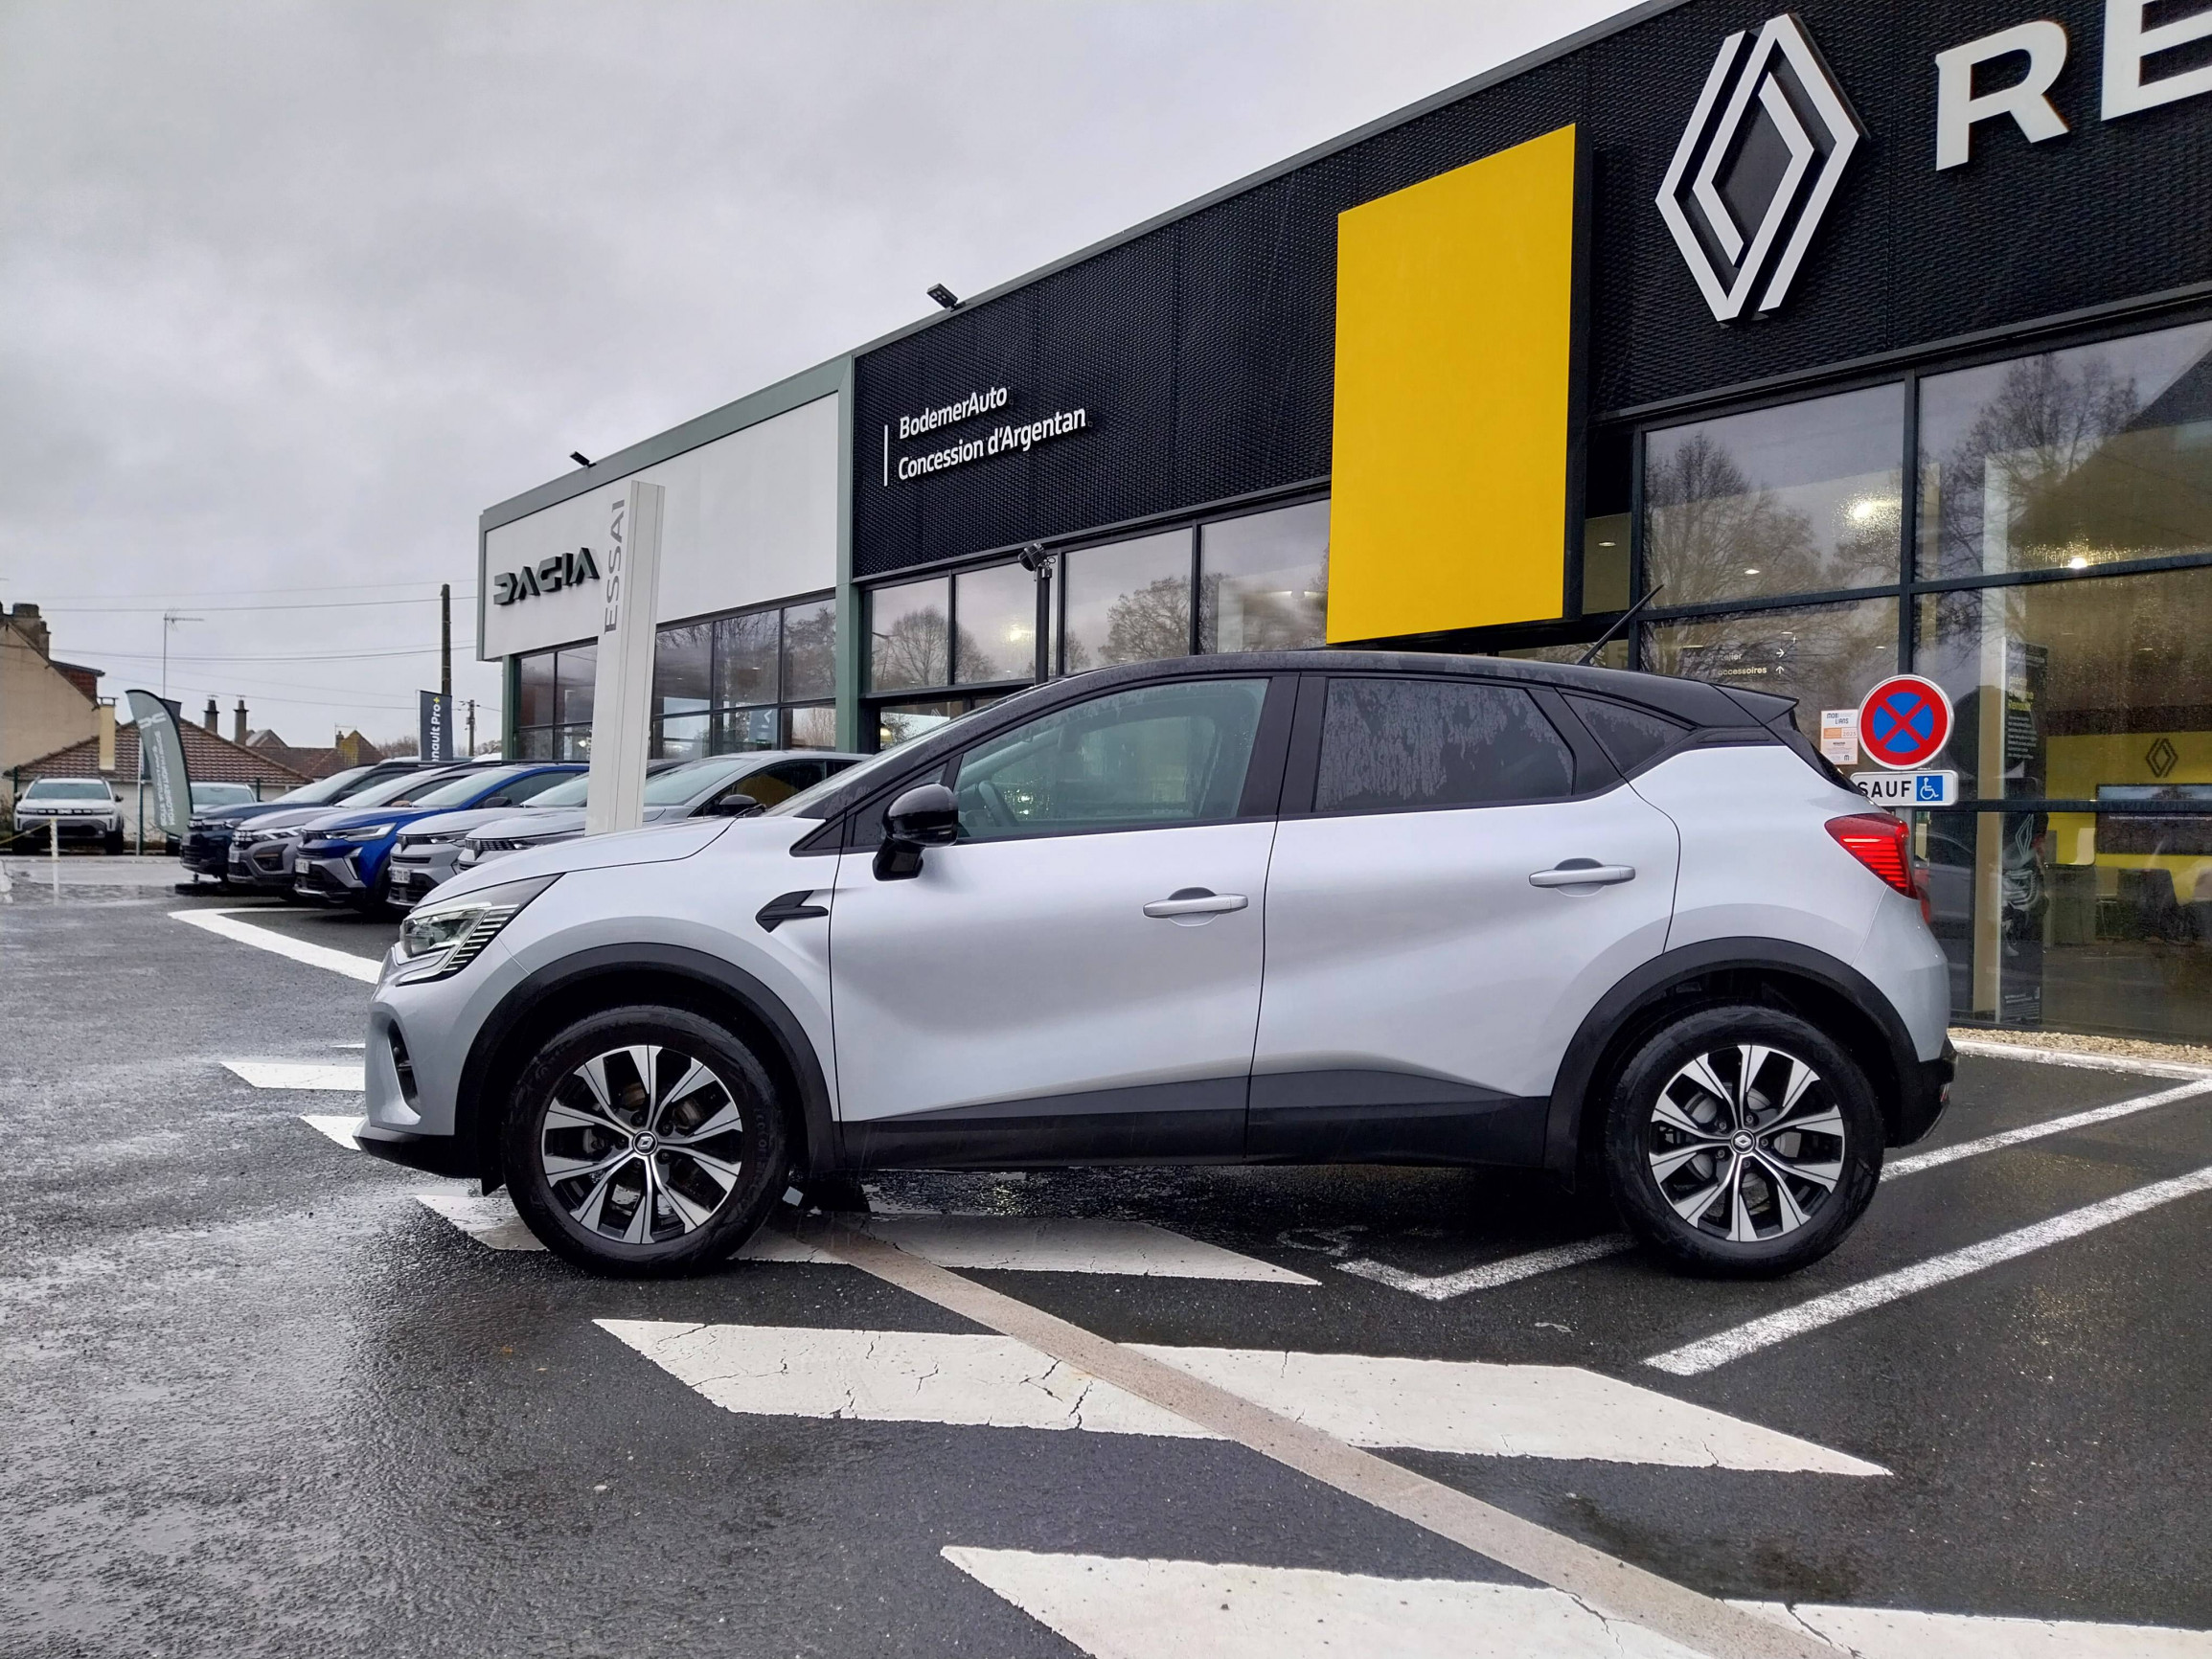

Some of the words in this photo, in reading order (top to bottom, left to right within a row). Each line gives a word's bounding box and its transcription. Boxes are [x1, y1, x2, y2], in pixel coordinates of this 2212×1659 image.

[900, 386, 1007, 440] BodemerAuto
[899, 439, 984, 480] Concession
[988, 408, 1086, 456] d'Argentan
[493, 547, 600, 604] DACIA
[604, 499, 625, 634] ESSAI
[430, 725, 441, 761] nault
[1858, 781, 1911, 798] SAUF
